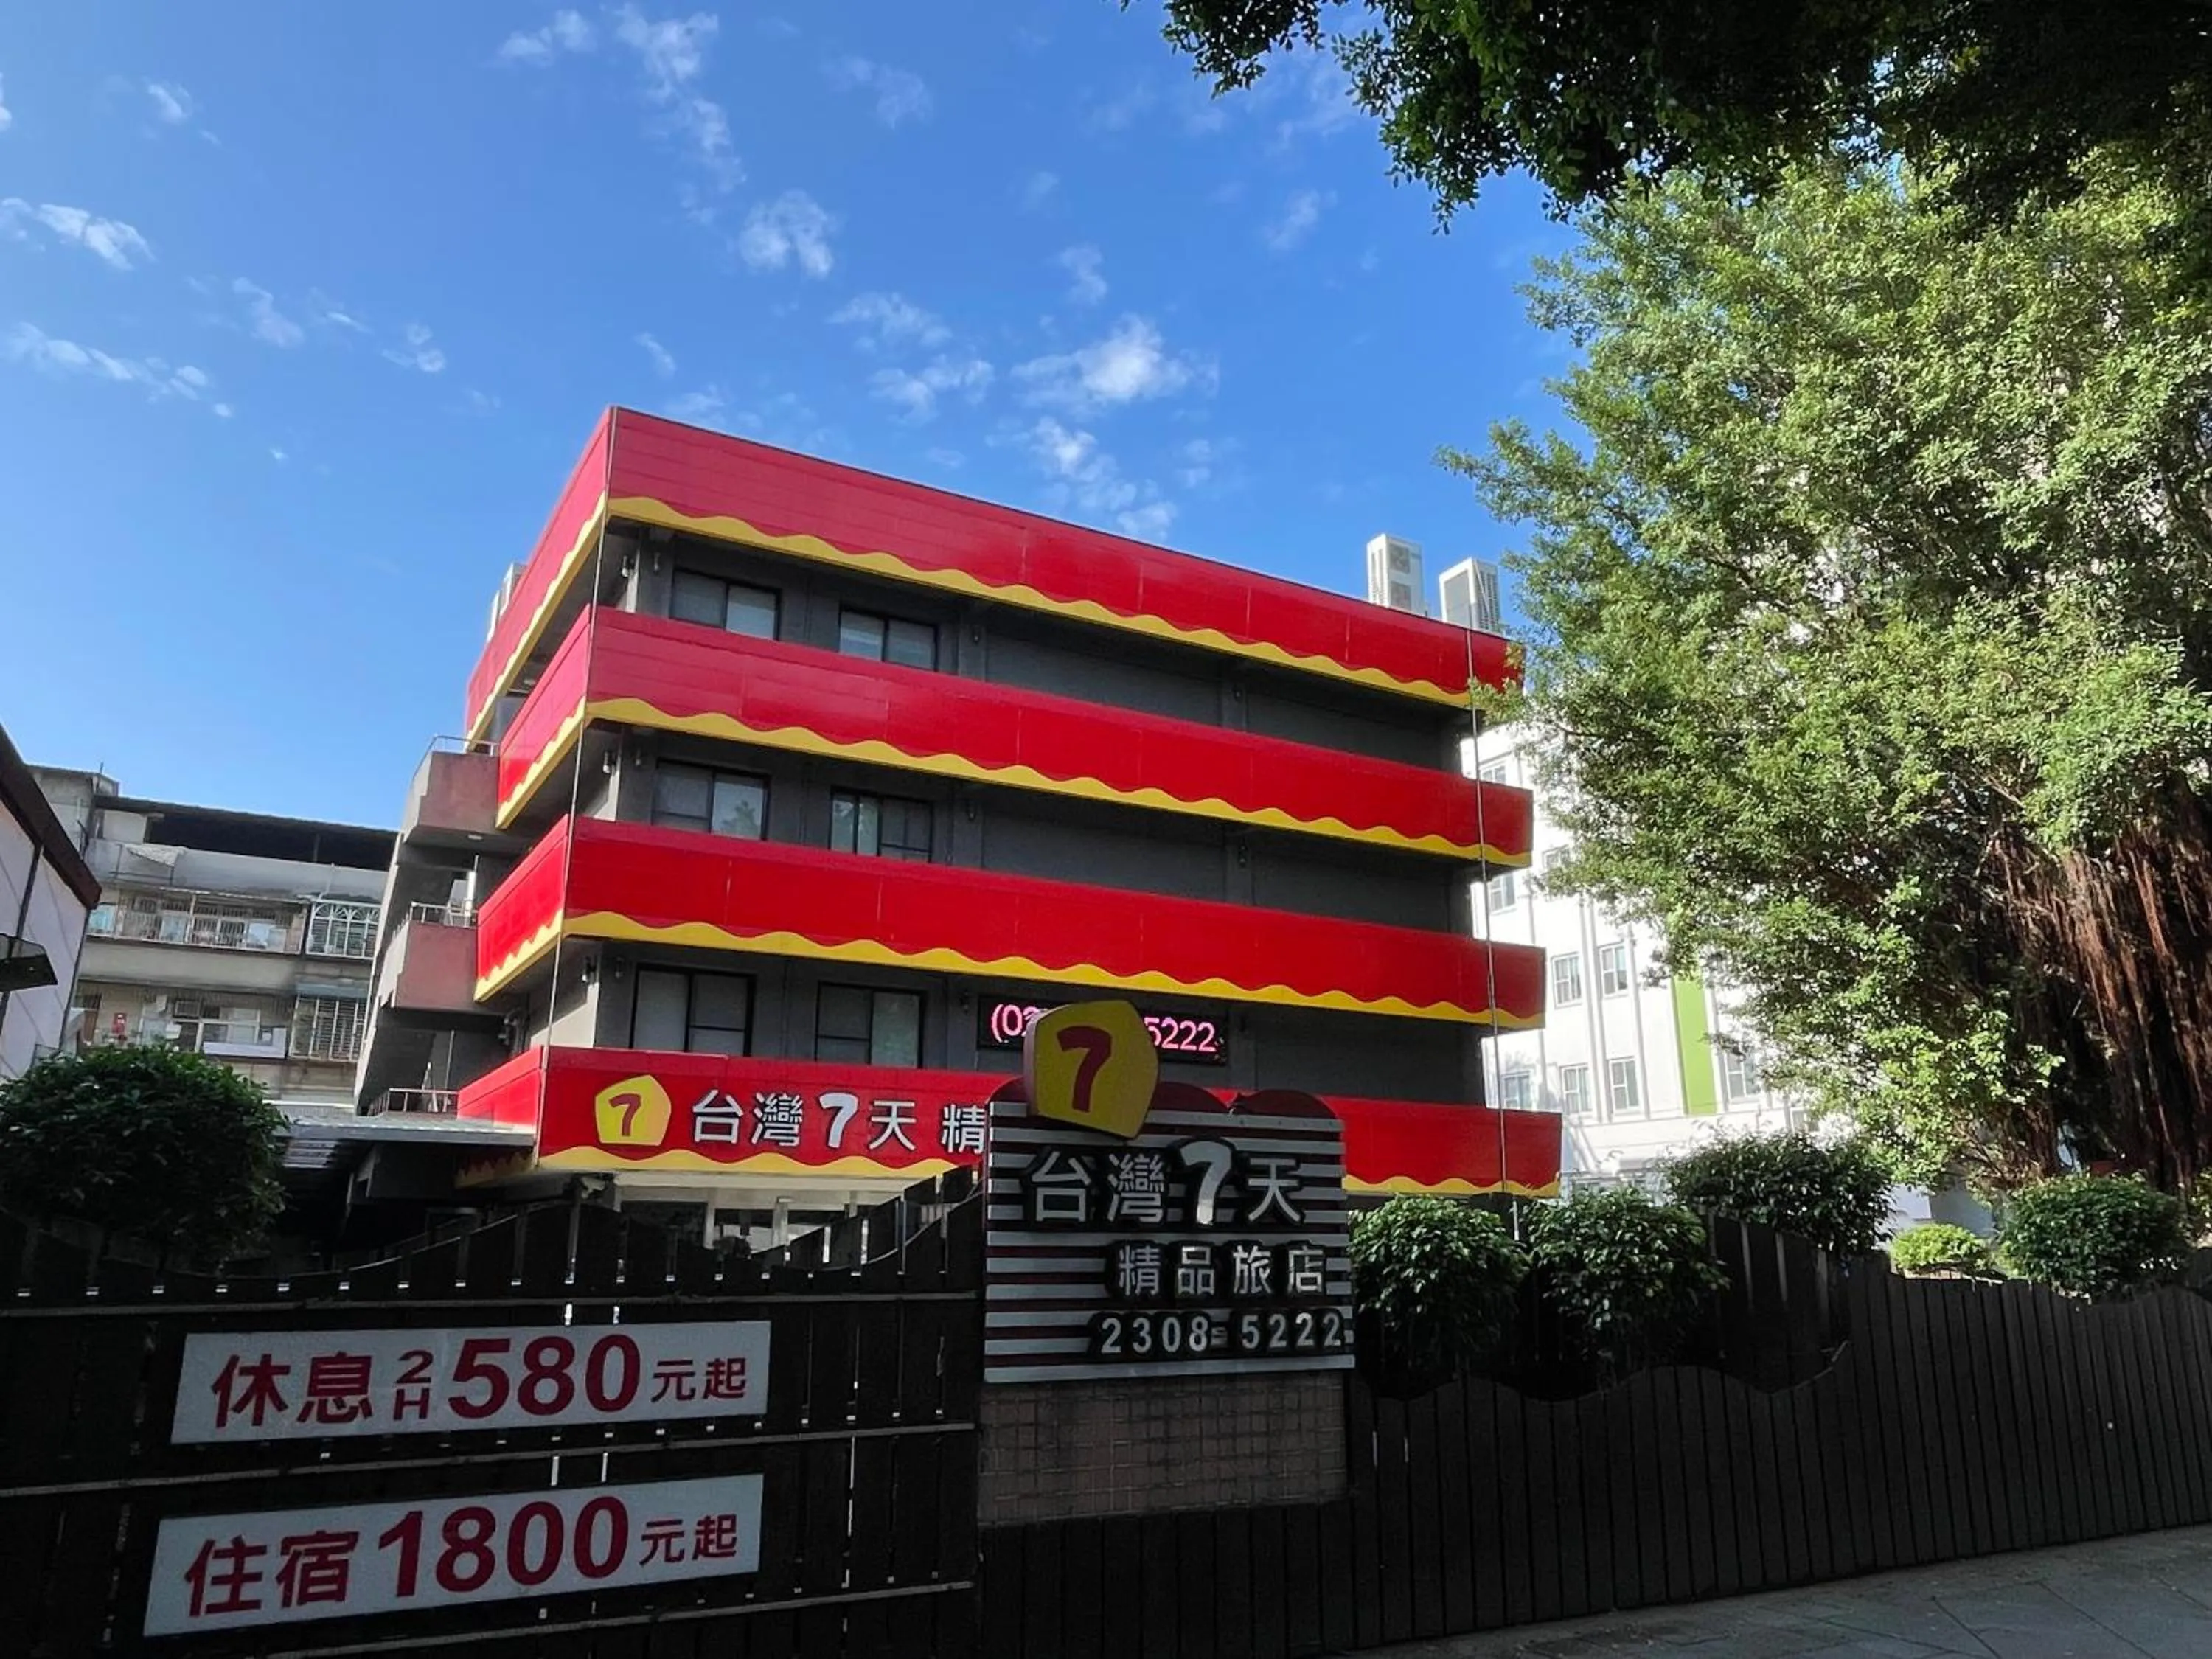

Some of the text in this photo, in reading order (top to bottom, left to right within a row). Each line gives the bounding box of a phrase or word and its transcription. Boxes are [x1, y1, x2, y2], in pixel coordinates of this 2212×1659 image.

[1144, 1017, 1216, 1052] 5222
[1057, 1026, 1111, 1111] 7
[609, 1094, 641, 1136] 7
[1034, 1140, 1304, 1225] 台灣7天
[1119, 1246, 1325, 1296] 精品旅店
